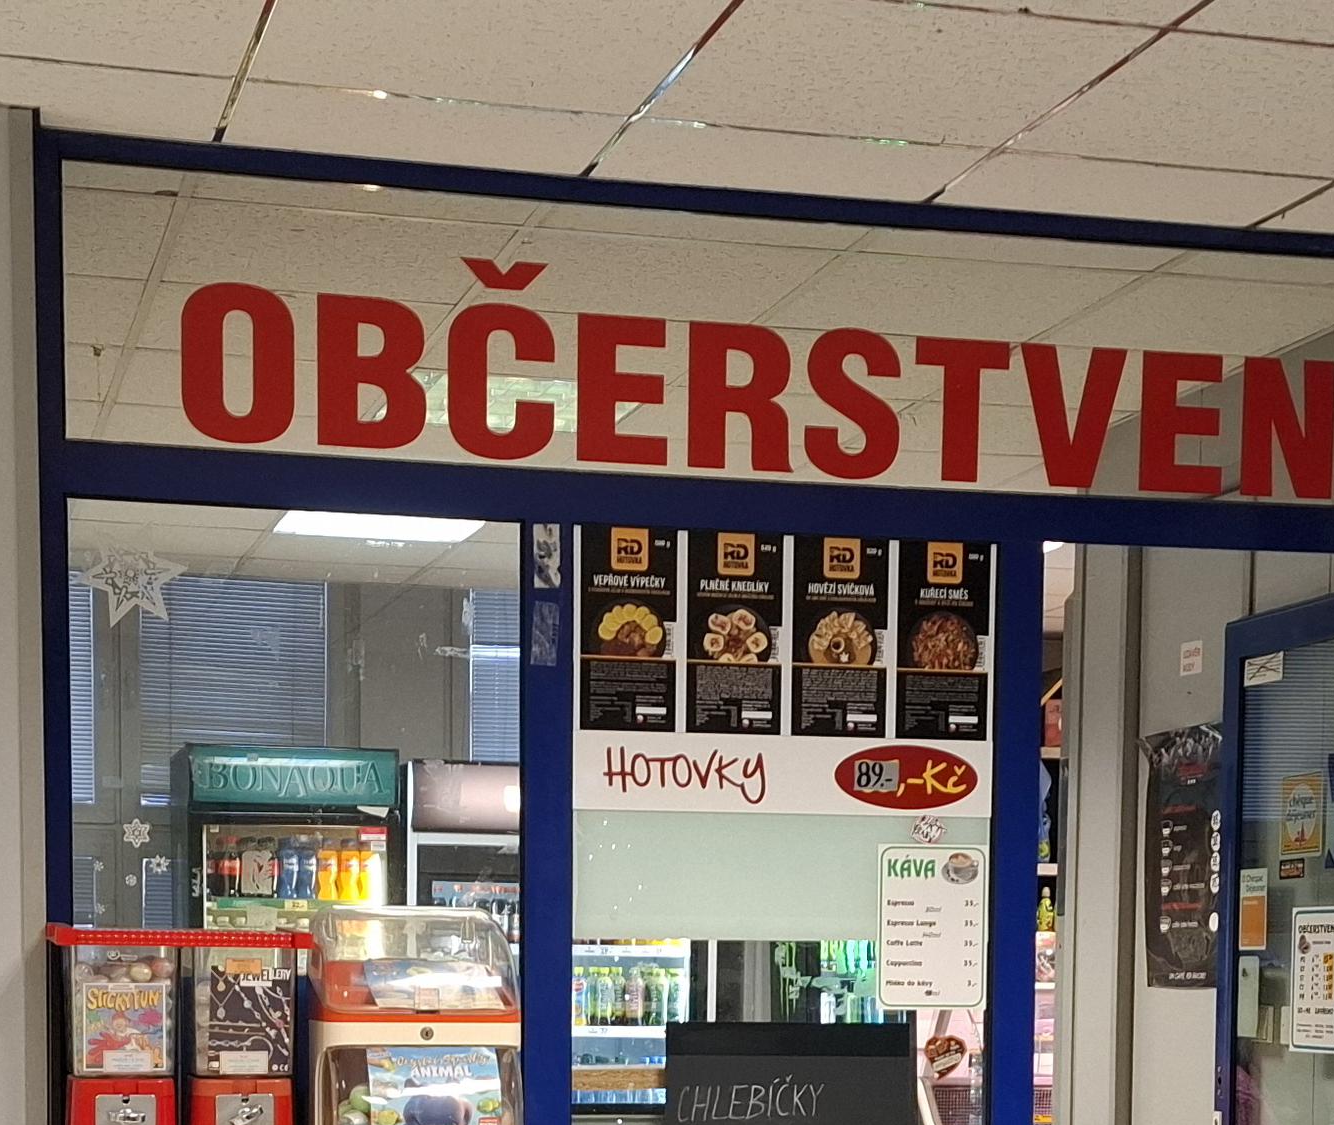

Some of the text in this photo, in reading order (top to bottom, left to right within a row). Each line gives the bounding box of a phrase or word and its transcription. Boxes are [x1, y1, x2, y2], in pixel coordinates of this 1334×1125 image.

[617, 538, 643, 555] RD
[723, 543, 749, 560] RD
[829, 546, 855, 564] RD
[932, 552, 957, 569] RD
[593, 573, 665, 588] VEPŘOVÉ VÝPEČKY
[700, 578, 769, 593] PLNĚNÉ KNEDLÍKY
[808, 581, 875, 596] HOVĚZÍ SVÍČKOVÁ
[920, 586, 969, 601] KUŘECÍ SMĚS
[204, 758, 390, 798] BONAQUA
[887, 854, 936, 879] KÁVA
[87, 987, 160, 1012] STICKY FUN
[411, 1064, 473, 1079] ANIMAL
[677, 1073, 825, 1123] CHLEBÍČKY
